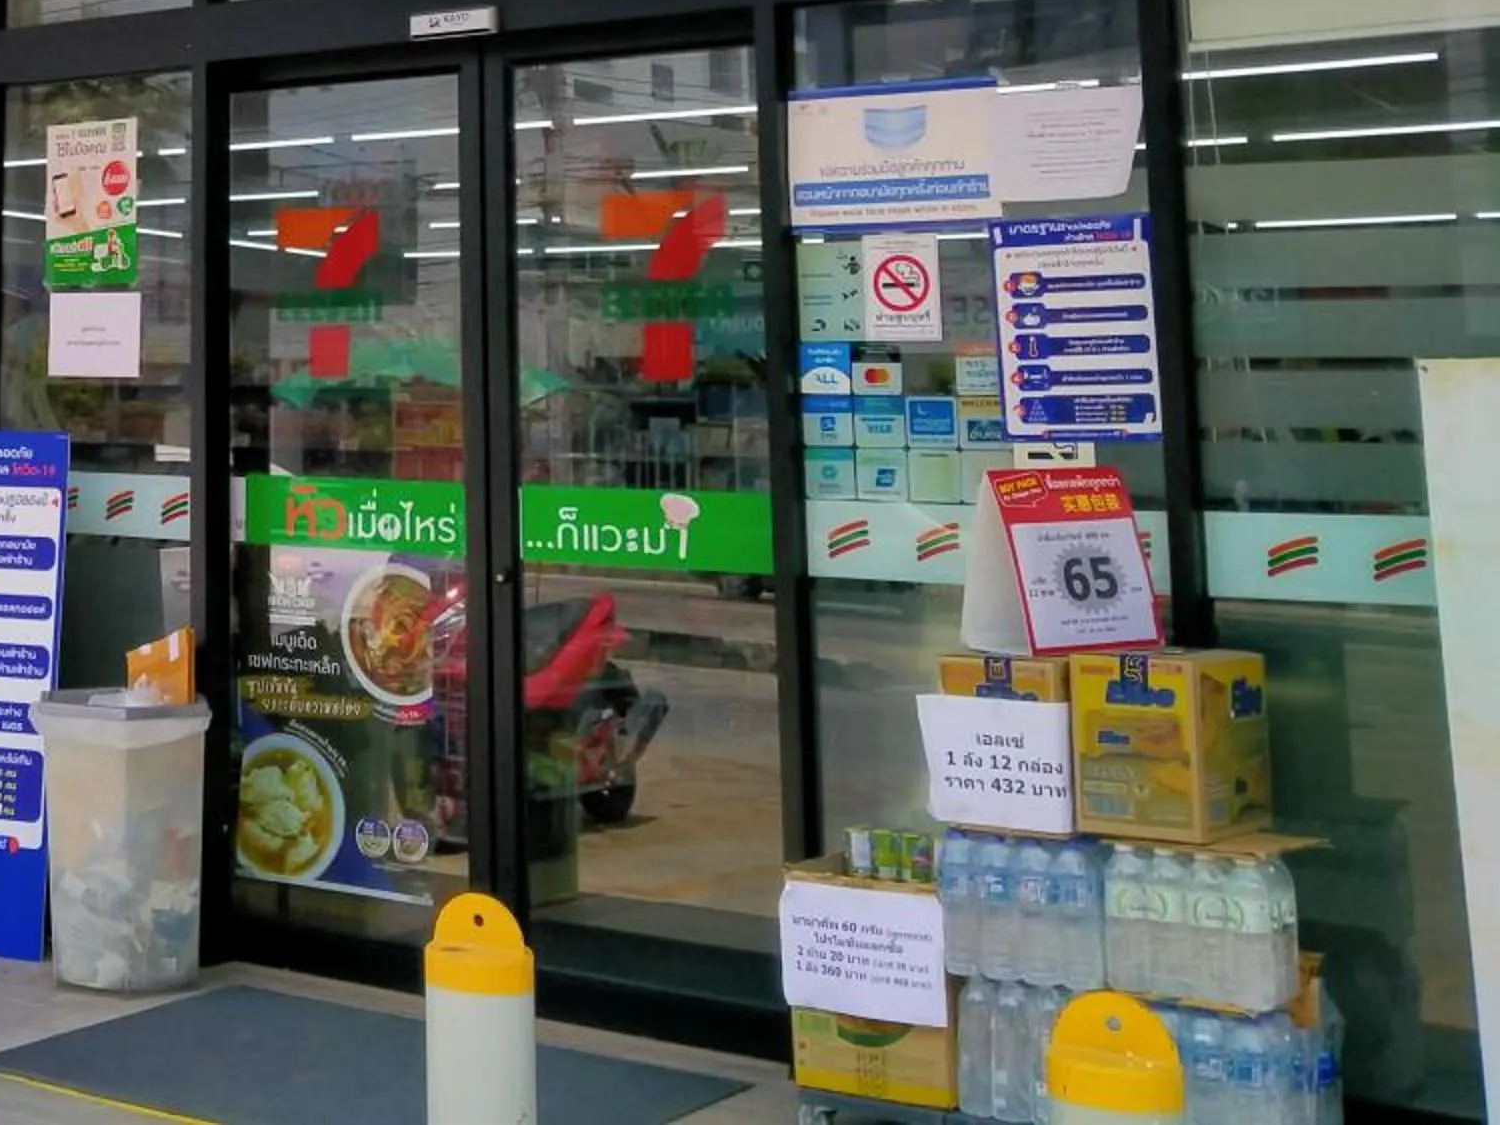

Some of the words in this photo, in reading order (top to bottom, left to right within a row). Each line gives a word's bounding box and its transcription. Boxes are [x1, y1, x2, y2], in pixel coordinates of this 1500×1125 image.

[1063, 556, 1119, 602] 65
[947, 750, 956, 766] 1
[963, 750, 982, 768] ลัง
[991, 755, 1011, 770] 12
[1017, 754, 1063, 775] กล่อง
[944, 776, 985, 792] ราคา
[991, 777, 1025, 795] 432
[1033, 784, 1068, 799] บาท
[841, 921, 857, 933] 60
[847, 954, 870, 966] บาท
[845, 969, 867, 981] บาท
